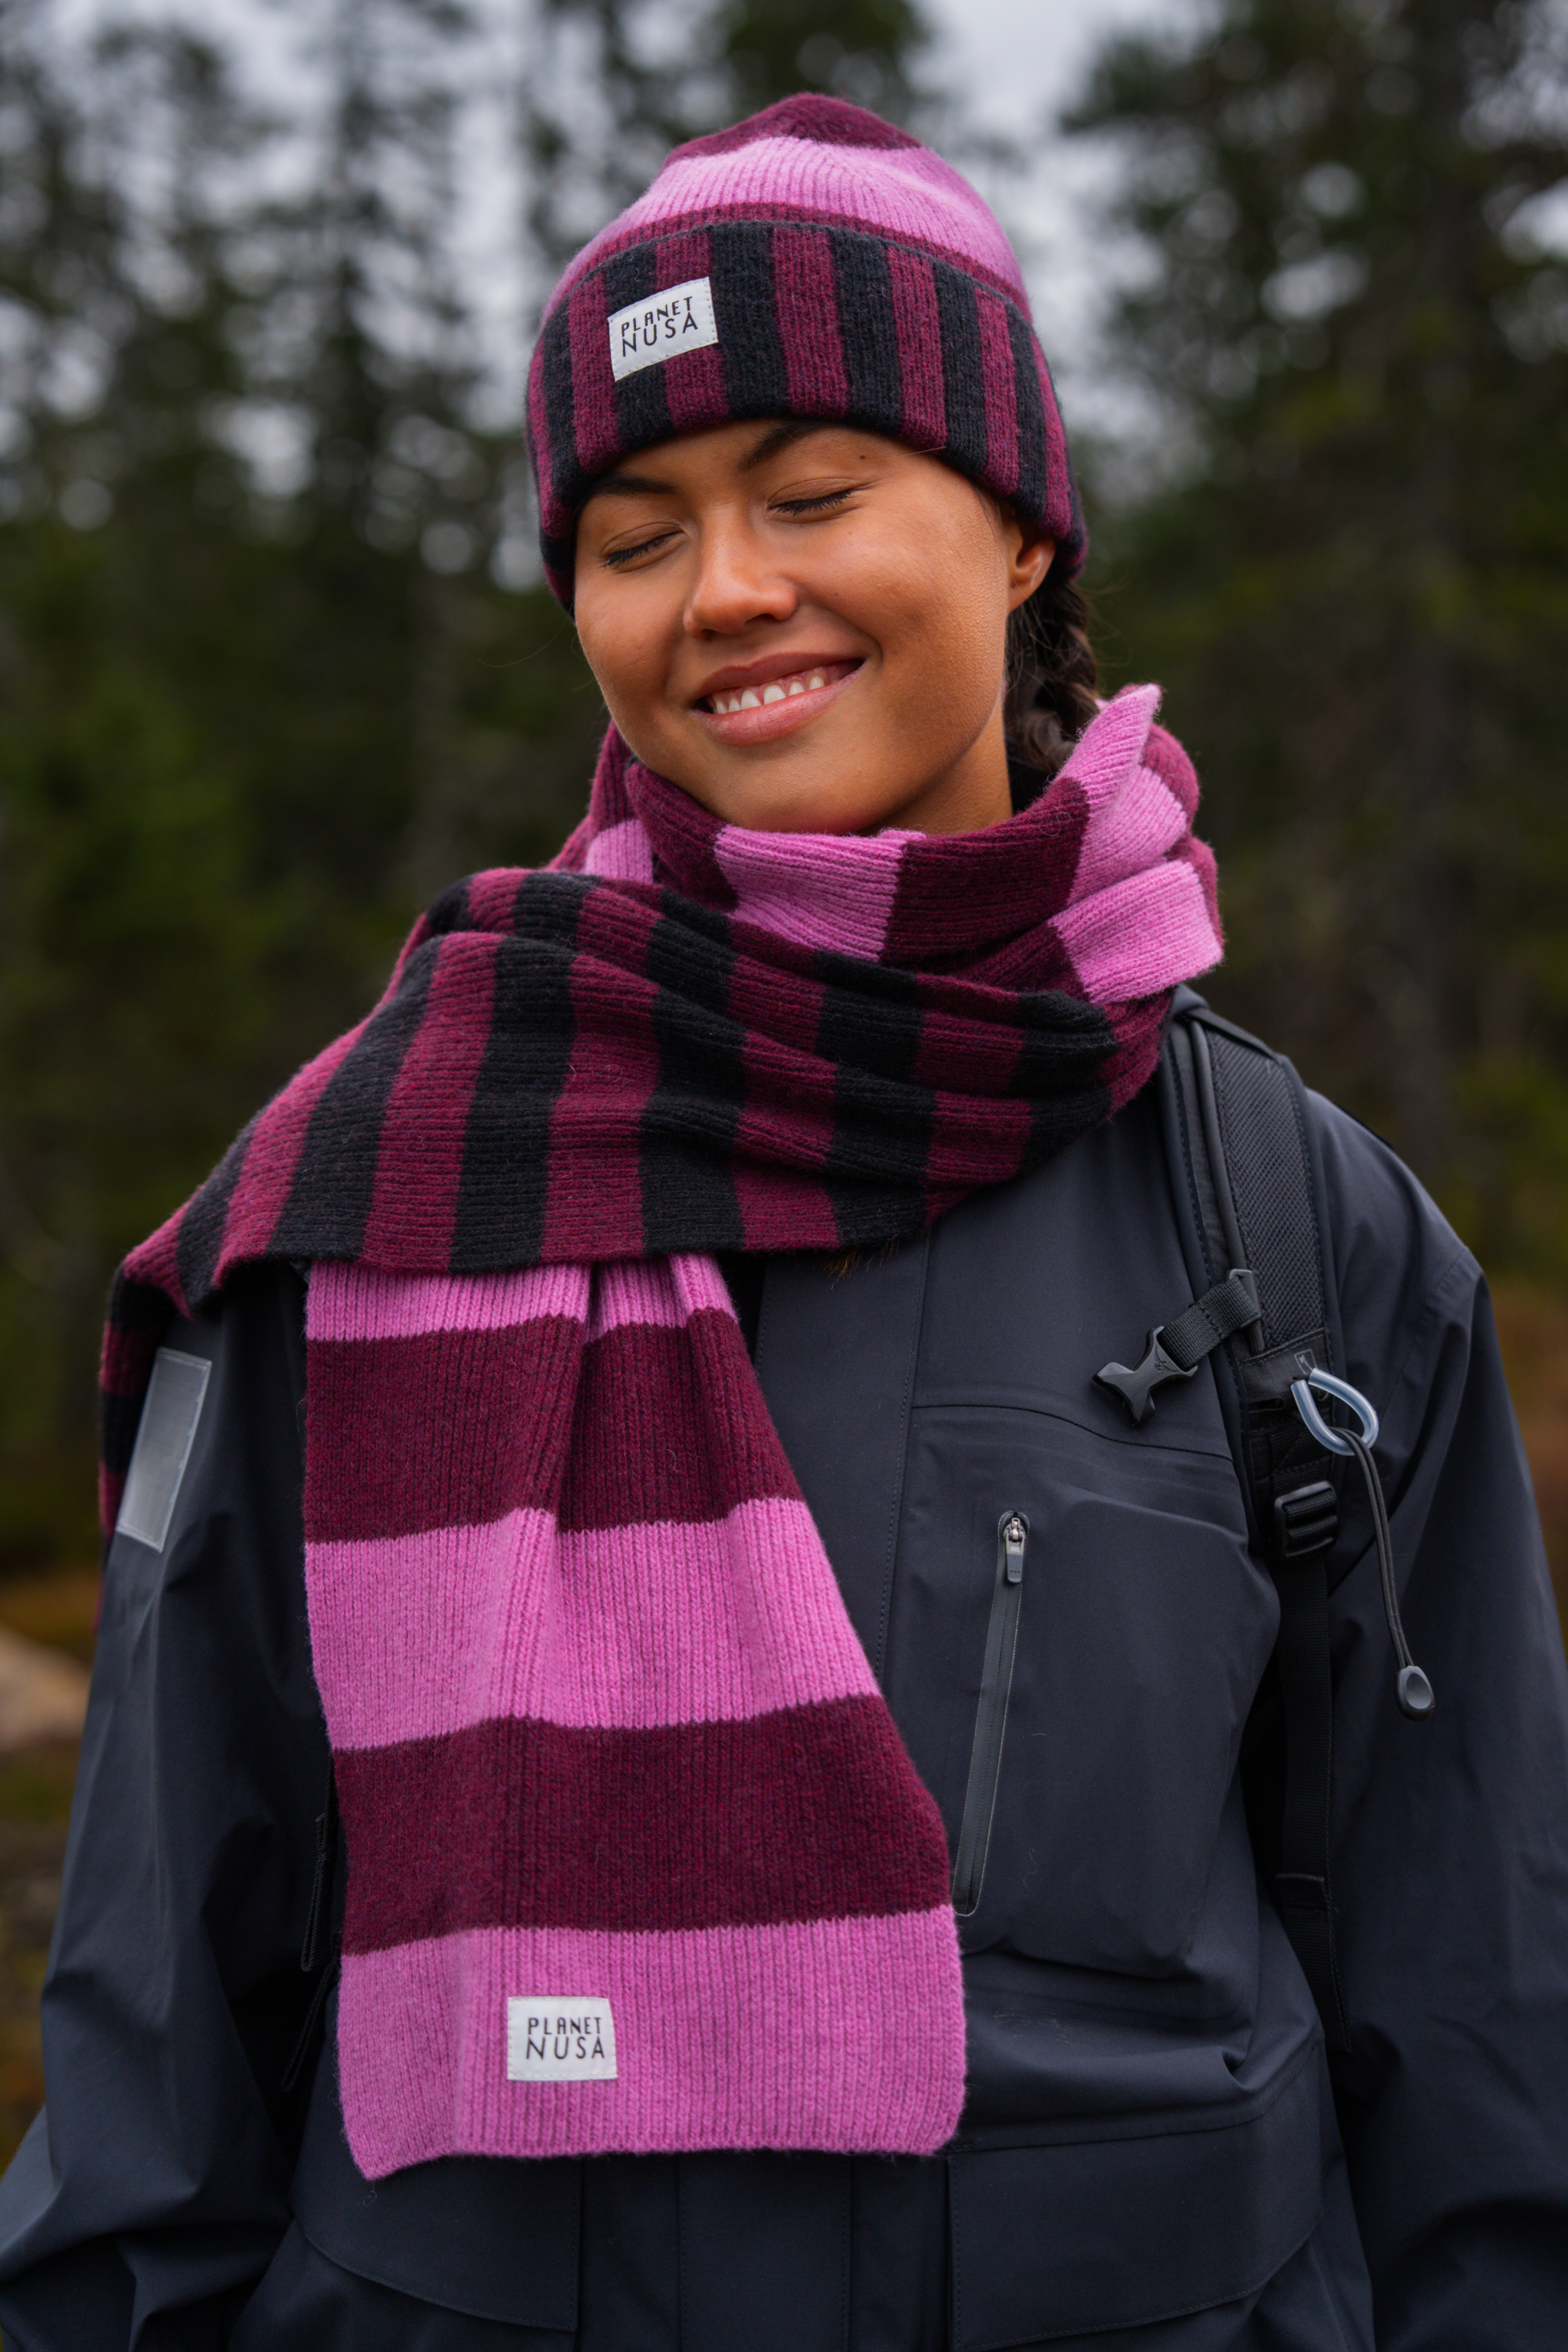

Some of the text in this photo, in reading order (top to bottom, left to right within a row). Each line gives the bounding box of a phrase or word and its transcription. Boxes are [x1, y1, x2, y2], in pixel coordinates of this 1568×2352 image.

[621, 296, 693, 338] PLANET
[622, 311, 698, 358] NUSA
[528, 2017, 601, 2035] PLANET
[526, 2036, 605, 2060] NUSA
